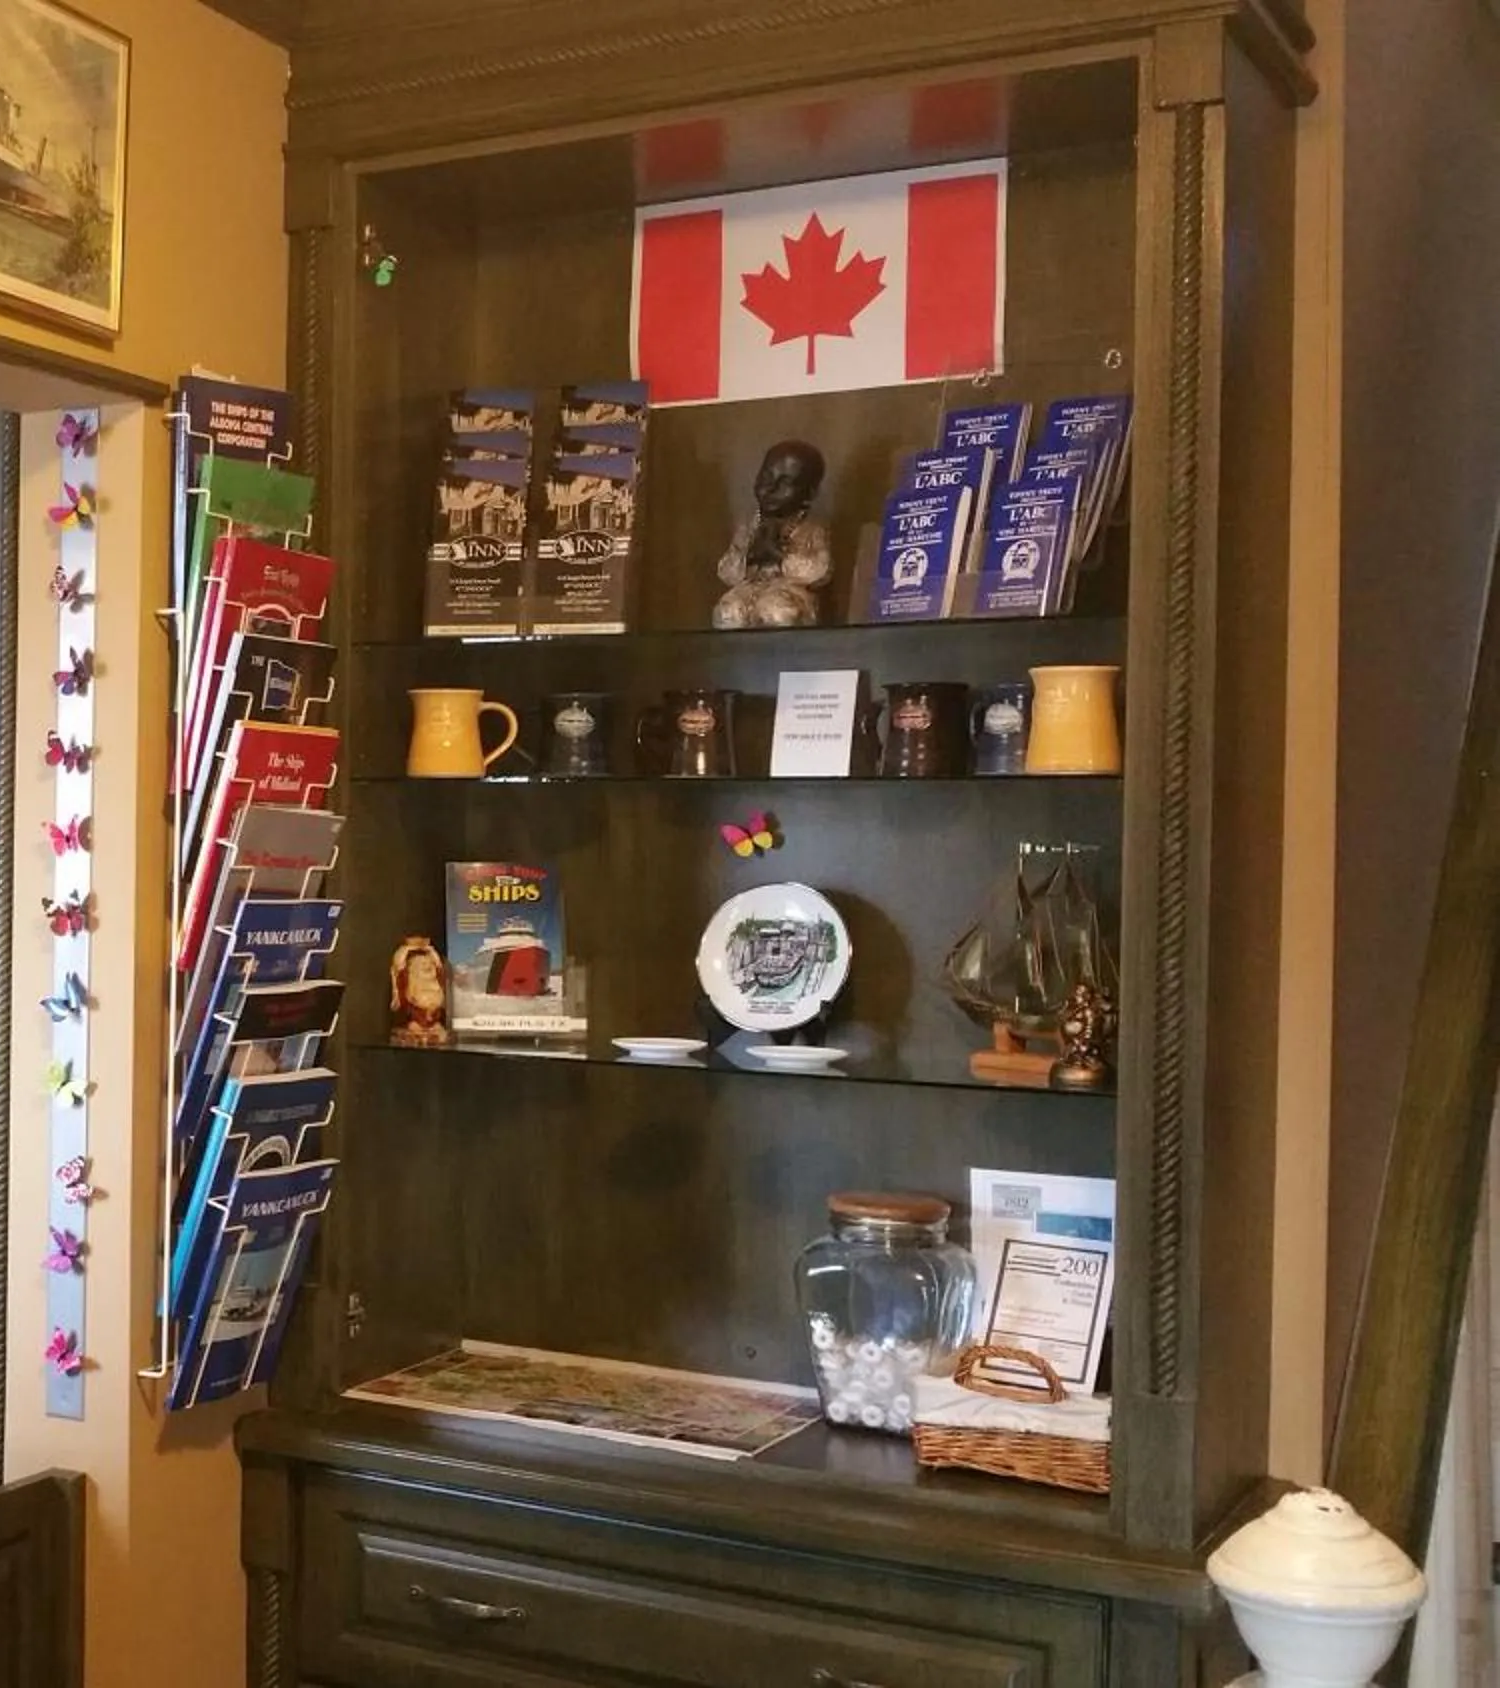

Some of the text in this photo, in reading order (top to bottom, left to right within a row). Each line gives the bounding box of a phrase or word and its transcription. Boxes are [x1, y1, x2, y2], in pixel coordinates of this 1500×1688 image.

[956, 431, 997, 447] L'ABC
[915, 471, 963, 489] L'ABC
[899, 513, 937, 531] L'ABC
[468, 541, 502, 557] INN
[576, 536, 611, 554] INN
[268, 752, 284, 768] The
[468, 884, 540, 903] SHIPS
[1062, 1257, 1099, 1277] 200
